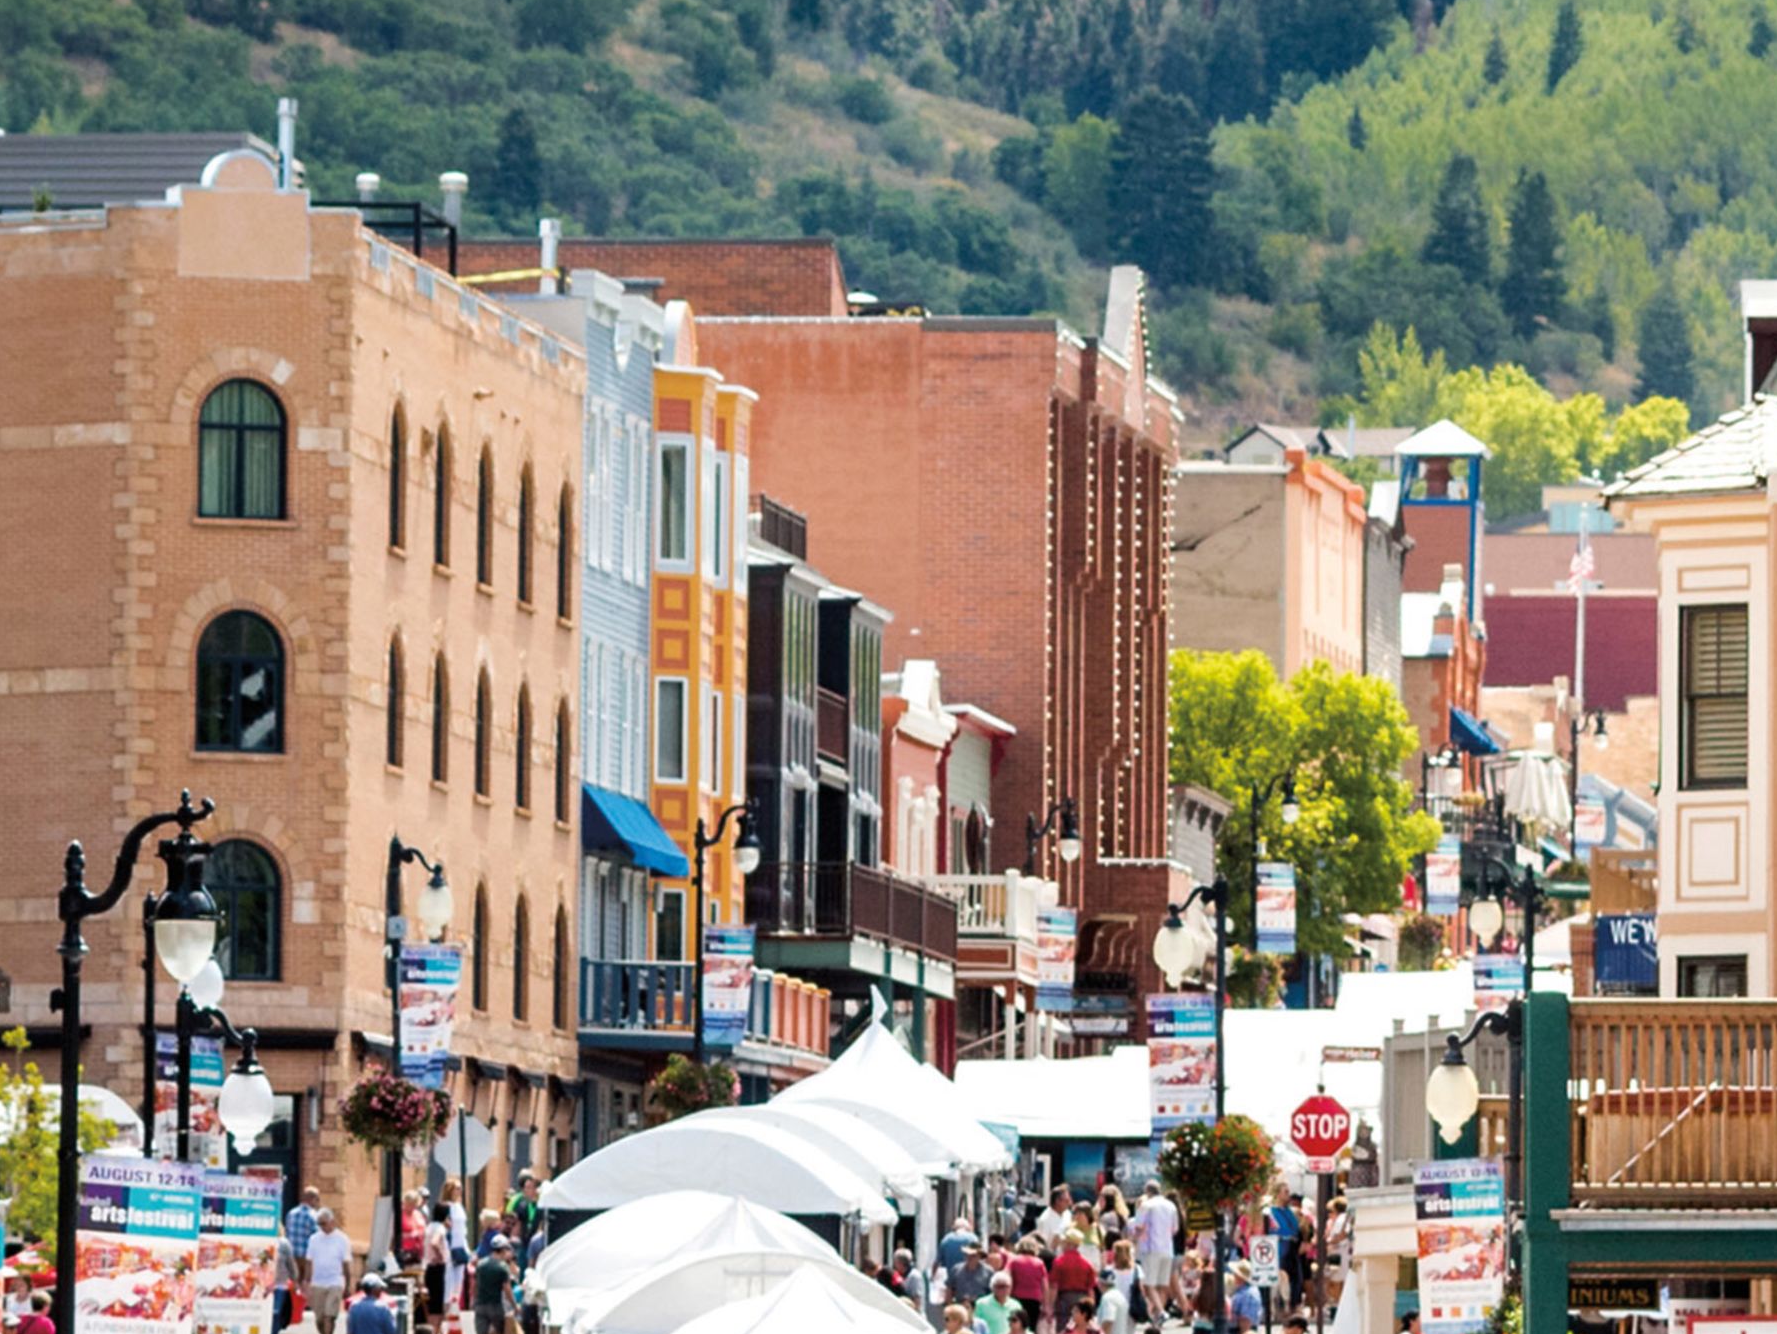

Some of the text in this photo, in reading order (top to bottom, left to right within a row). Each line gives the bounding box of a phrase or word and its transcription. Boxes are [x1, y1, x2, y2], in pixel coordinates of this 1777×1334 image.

[1610, 919, 1638, 944] WE
[1293, 1114, 1348, 1140] STOP
[89, 1166, 195, 1187] AUGUST 12-14
[202, 1184, 243, 1196] UGUST
[91, 1206, 194, 1230] artsfestival
